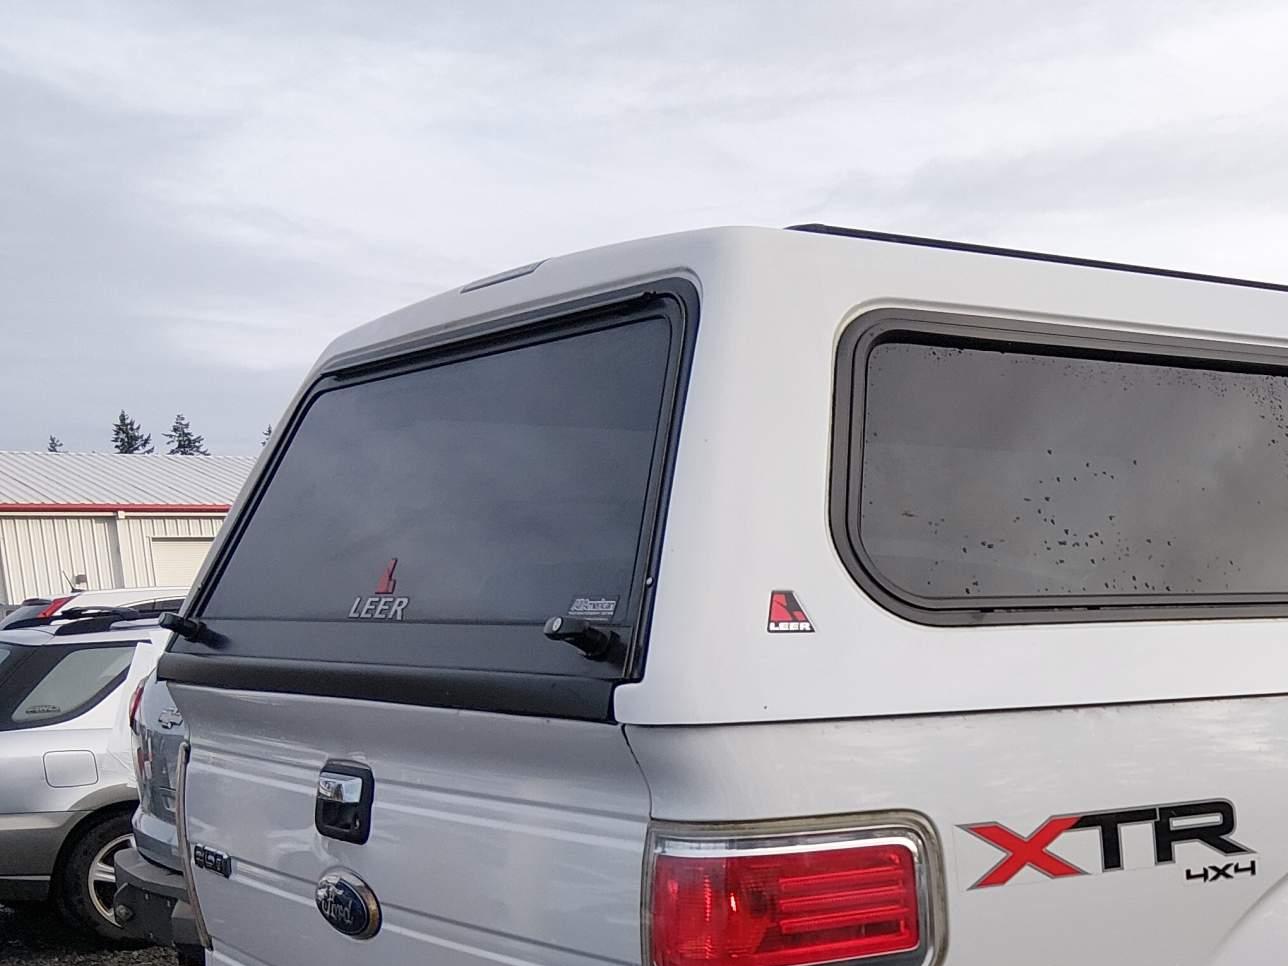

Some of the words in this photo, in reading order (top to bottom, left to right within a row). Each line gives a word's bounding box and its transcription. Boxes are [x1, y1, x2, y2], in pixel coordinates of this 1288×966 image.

[348, 596, 410, 620] LEER
[769, 622, 811, 631] LEER
[955, 797, 1257, 891] XTR
